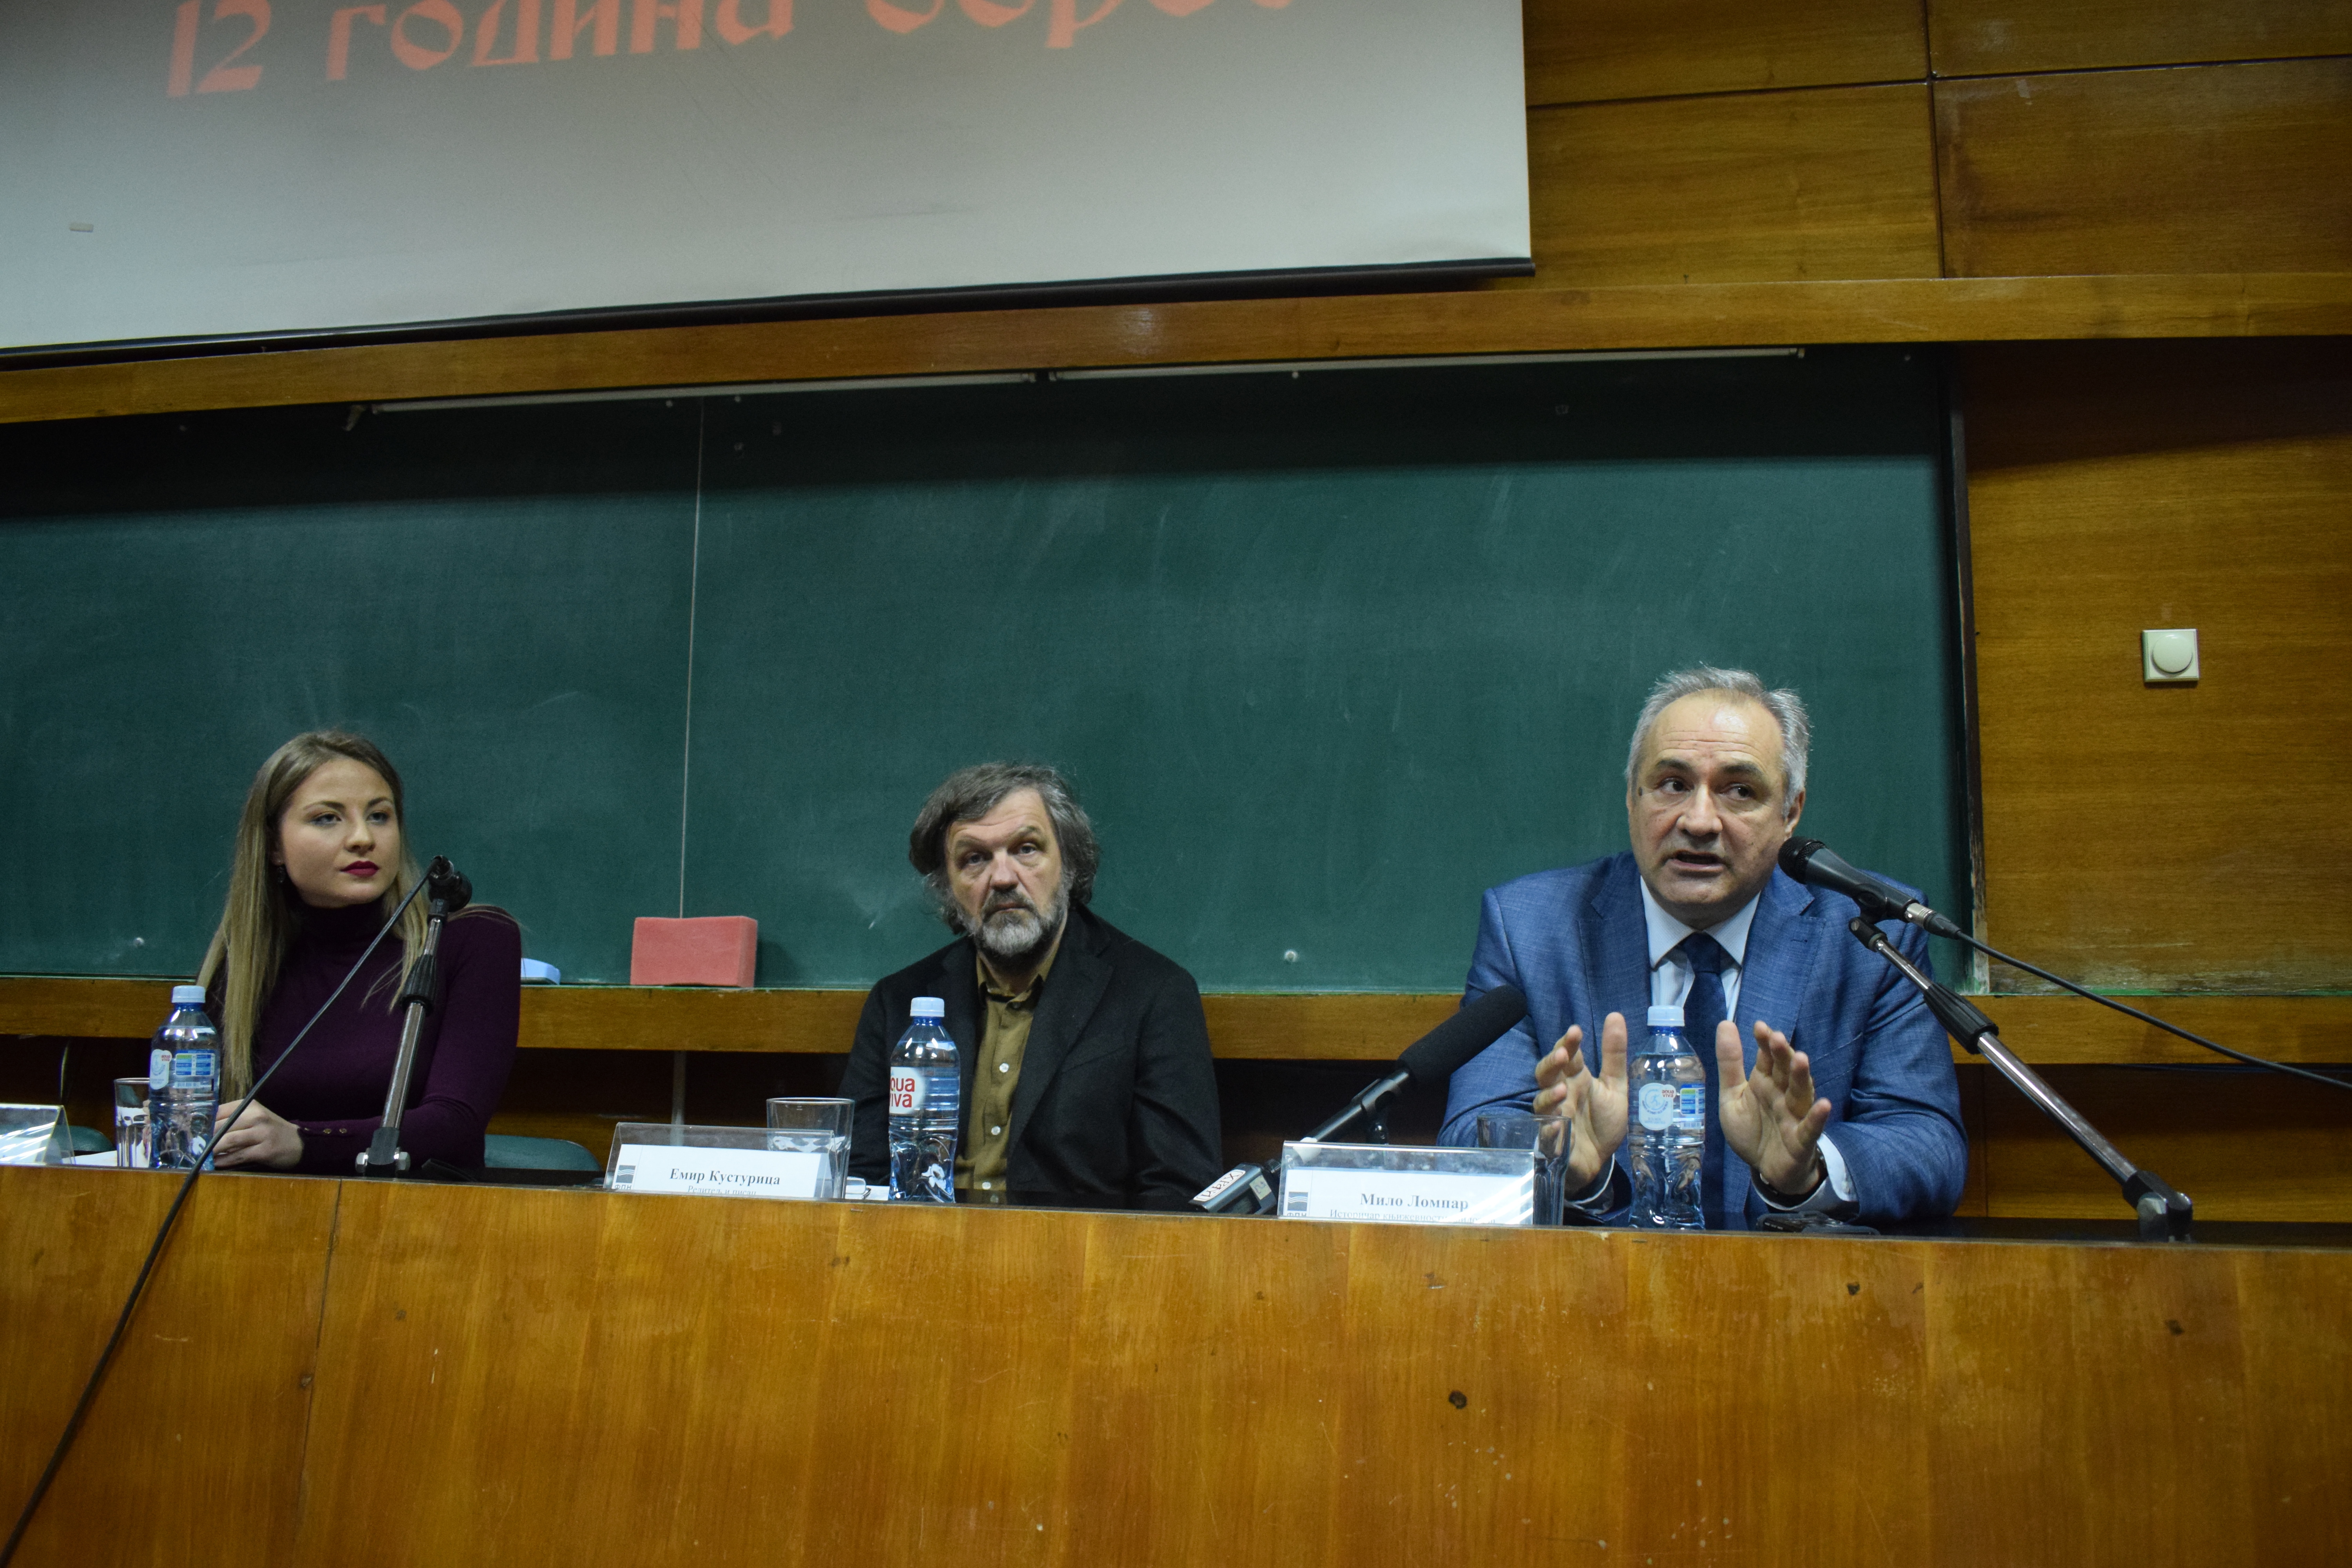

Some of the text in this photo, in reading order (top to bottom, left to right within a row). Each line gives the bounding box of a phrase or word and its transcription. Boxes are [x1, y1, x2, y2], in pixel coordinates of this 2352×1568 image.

[167, 0, 272, 98] 12
[325, 0, 795, 80] година
[890, 1077, 915, 1092] qua
[890, 1093, 912, 1107] iva
[670, 1168, 780, 1187] Емир Кустурица
[1360, 1193, 1468, 1212] Мило Ломпар
[1330, 1209, 1379, 1219] Историчар
